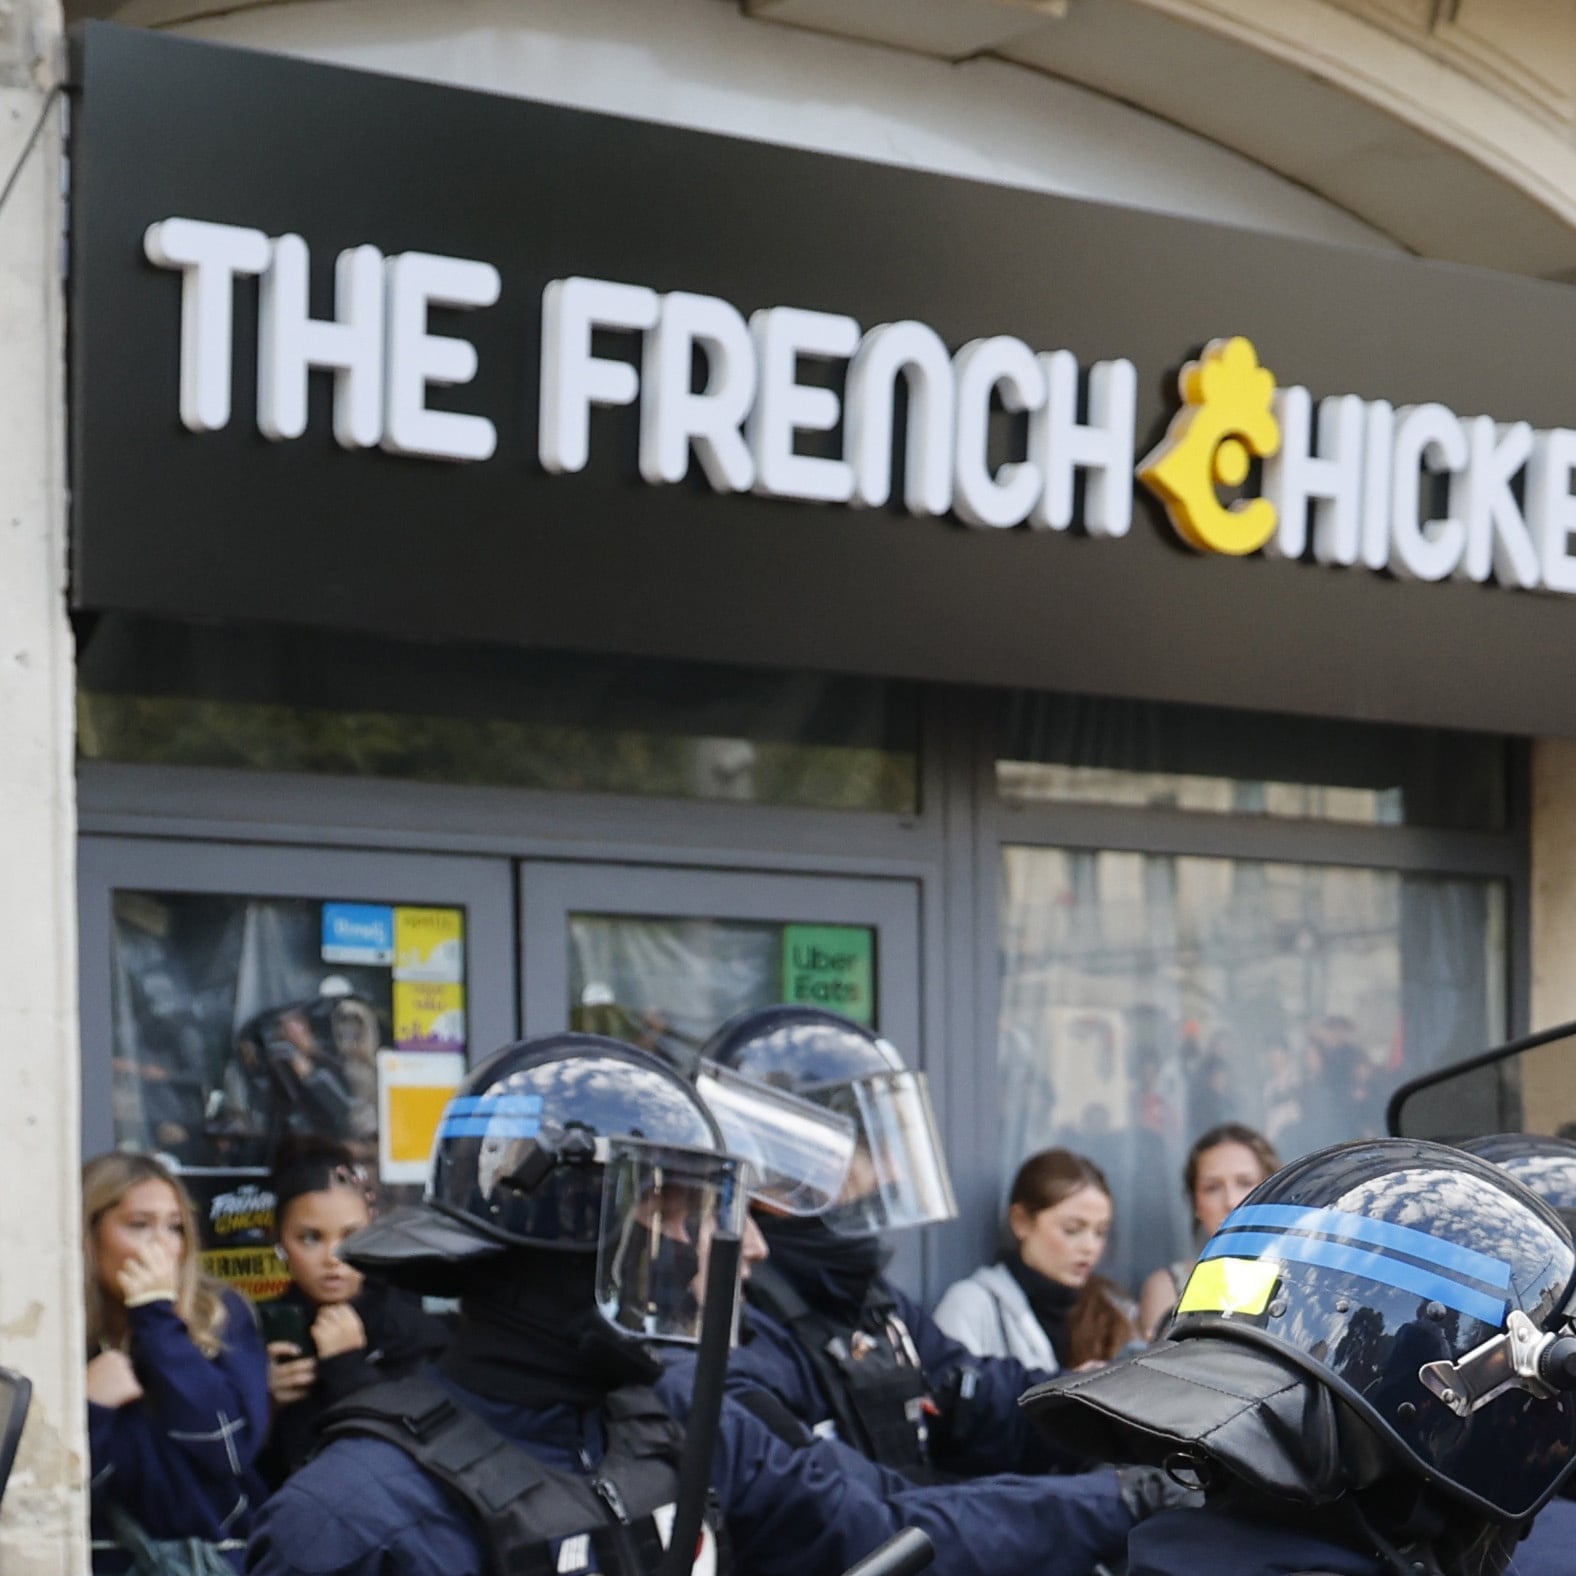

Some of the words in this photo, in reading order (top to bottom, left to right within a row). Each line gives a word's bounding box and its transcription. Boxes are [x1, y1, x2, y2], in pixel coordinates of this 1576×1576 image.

[144, 216, 501, 461] THE
[539, 275, 1137, 538] FRENCH
[791, 944, 857, 971] Uber
[793, 974, 861, 1003] Eats
